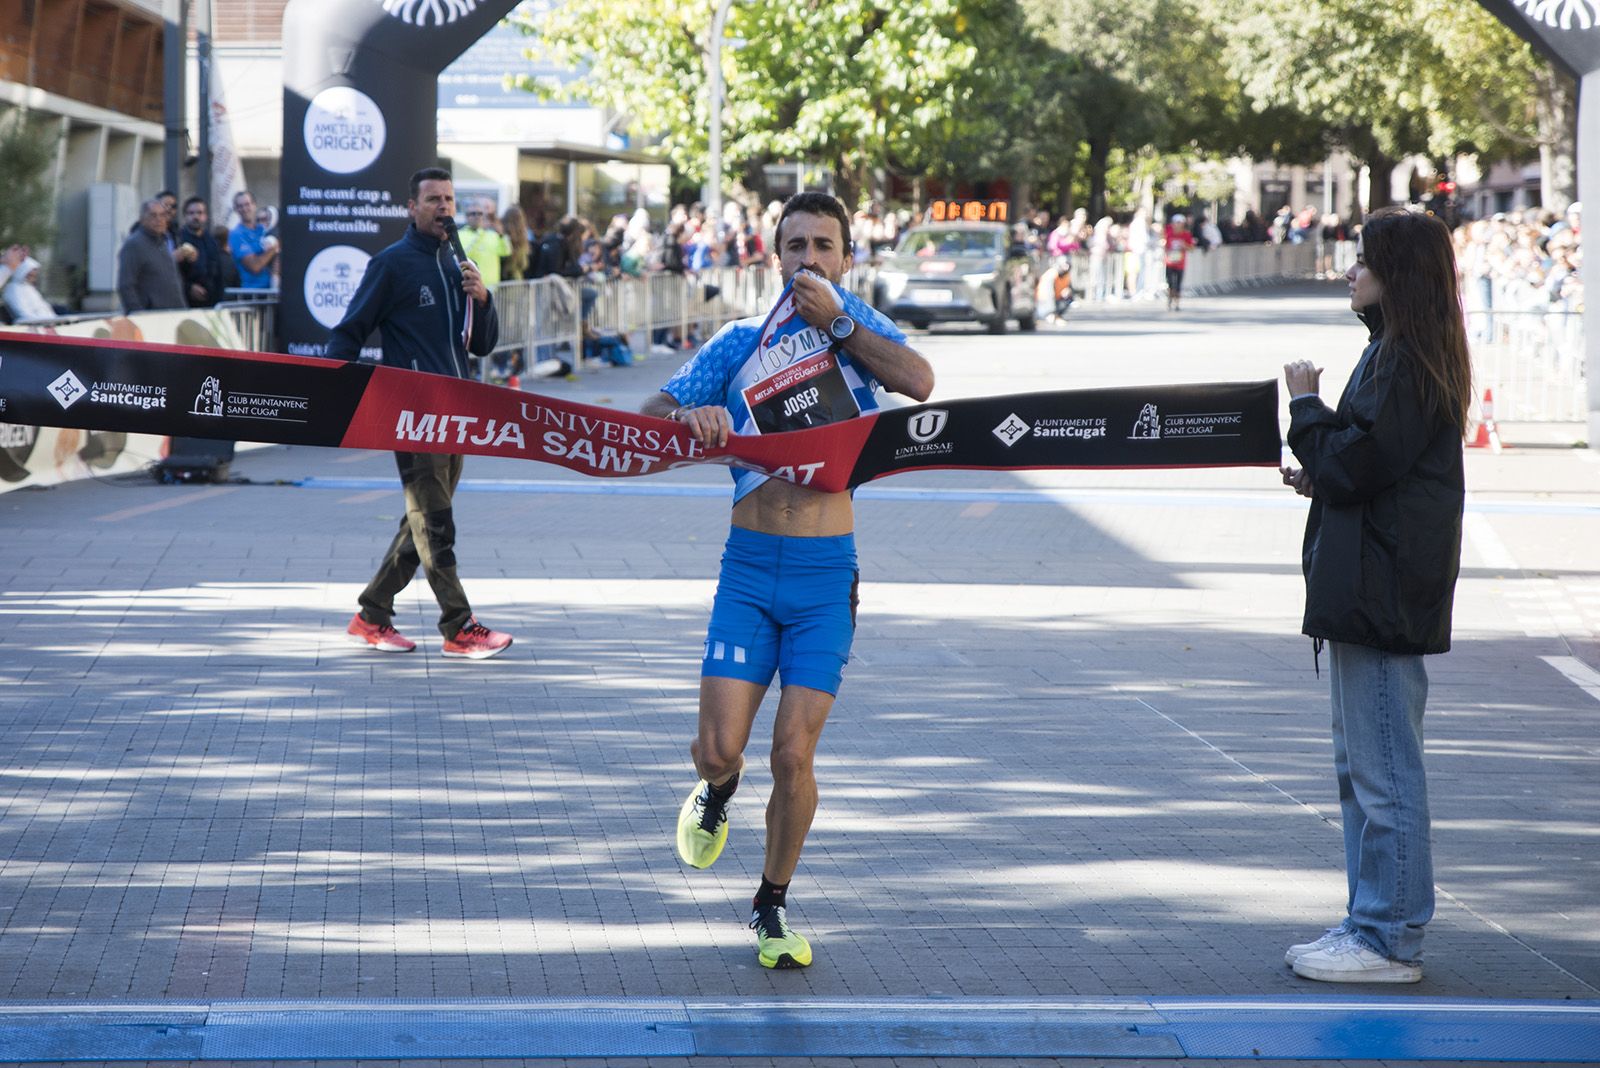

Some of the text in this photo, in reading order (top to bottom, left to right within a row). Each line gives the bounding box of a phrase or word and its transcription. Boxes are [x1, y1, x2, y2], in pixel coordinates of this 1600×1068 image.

[313, 123, 373, 136] AMETLLER
[313, 135, 374, 151] ORIGEN
[357, 189, 380, 203] cap
[381, 190, 391, 201] a
[351, 204, 410, 218] saludable
[313, 293, 352, 308] ORIG
[754, 359, 830, 401] MITJA SANT CUGAT 23
[92, 381, 167, 396] AJUNTAMENT DE
[90, 390, 167, 410] SantCugat
[227, 395, 309, 410] CLUB MUNTANYENC
[783, 386, 820, 417] JOSEP
[226, 405, 279, 417] SANT CUGAT
[804, 412, 813, 425] 1
[1034, 418, 1107, 427] AJUNTAMENT DE
[1164, 416, 1241, 426] CLUB MUNTANYENC
[519, 401, 706, 460] UNIVERSAE
[1033, 426, 1106, 440] SantCugat
[1164, 425, 1214, 435] SANT CUGAT
[395, 409, 525, 449] MITJA
[542, 431, 661, 474] SANT
[895, 442, 954, 456] UNIVERSAE
